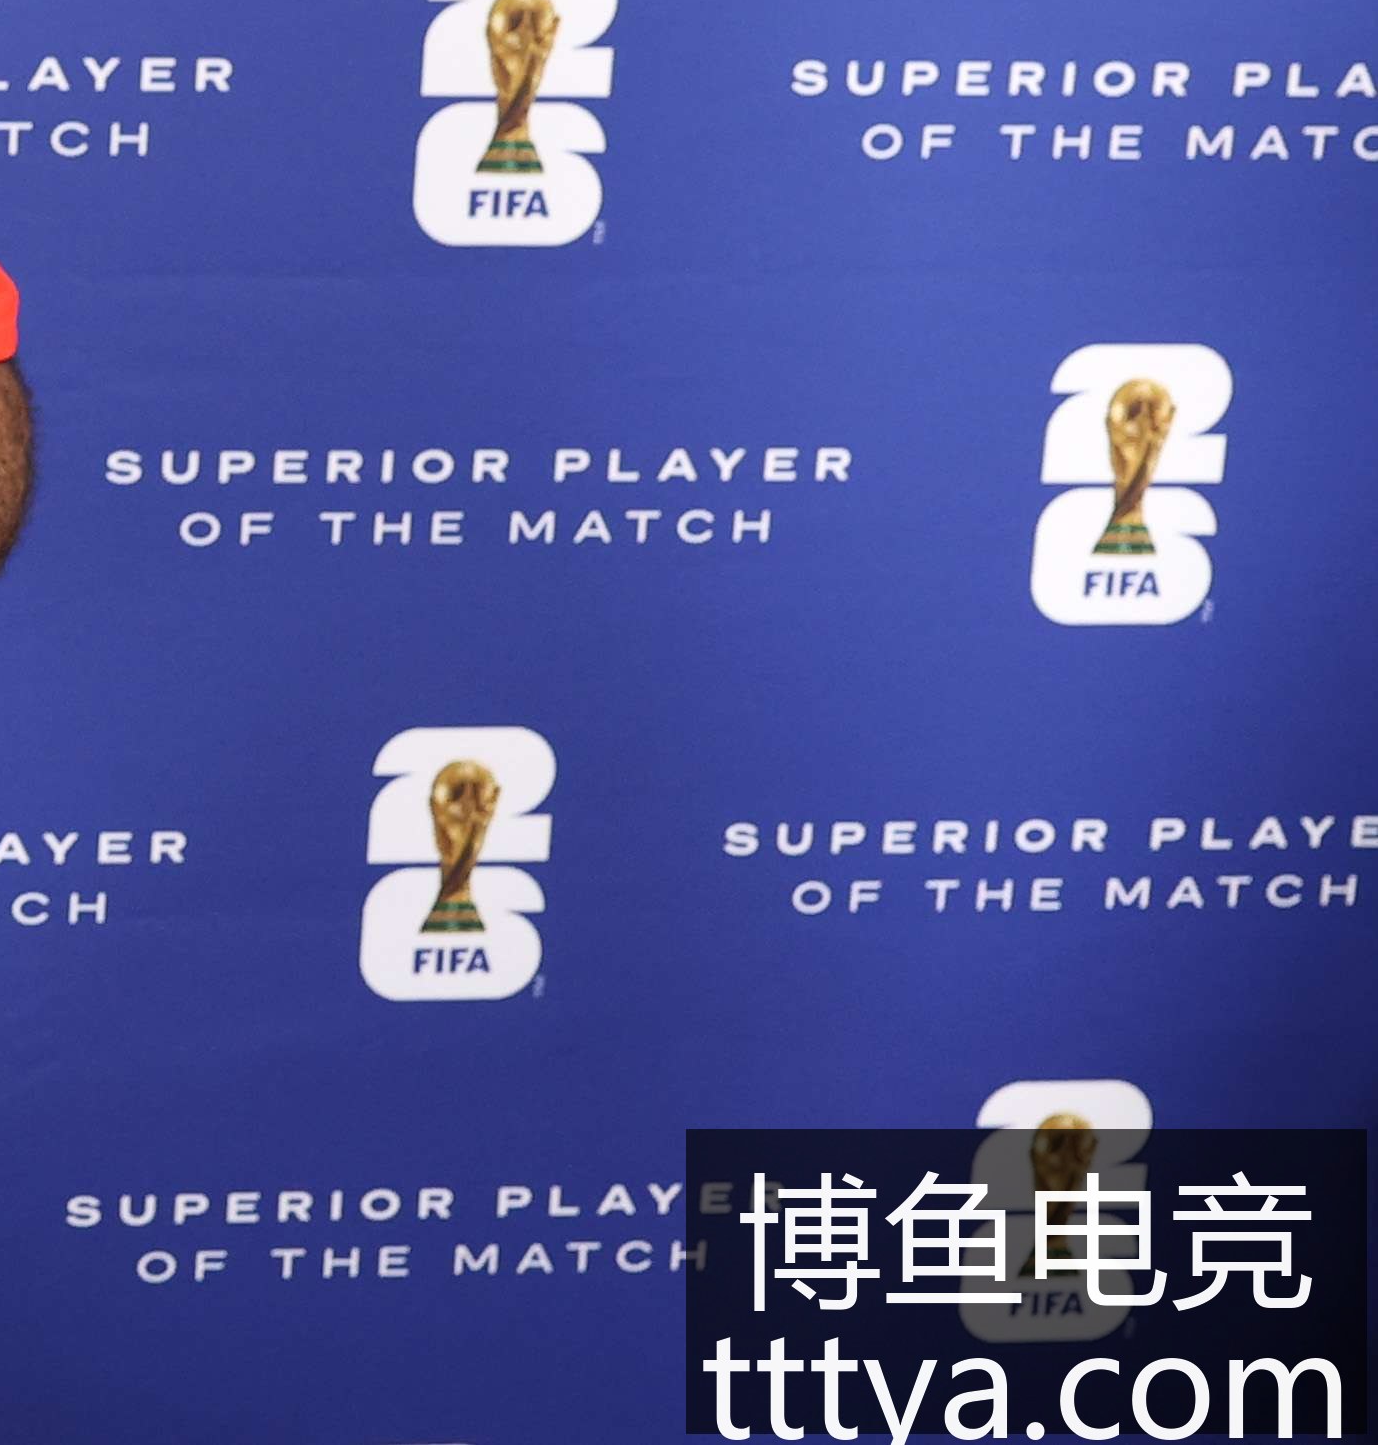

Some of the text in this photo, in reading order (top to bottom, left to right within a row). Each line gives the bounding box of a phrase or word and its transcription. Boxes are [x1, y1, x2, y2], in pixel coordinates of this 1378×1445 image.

[790, 59, 1378, 98] SUPERIOR PLA
[861, 123, 1378, 162] OF THE MATC
[468, 190, 549, 218] FIFA
[105, 446, 852, 486] SUPERIOR PLAYER
[179, 508, 772, 547] OF THE MATCH
[1083, 571, 1159, 596] FIFA
[722, 814, 1378, 857] SUPERIOR PLAYE
[791, 873, 1358, 916] OF THE MATCH
[413, 948, 490, 974] FIFA
[65, 1186, 454, 1228] SUPERIOR
[136, 1239, 708, 1284] OF THE MATCH
[1010, 1290, 1084, 1318] FIFA
